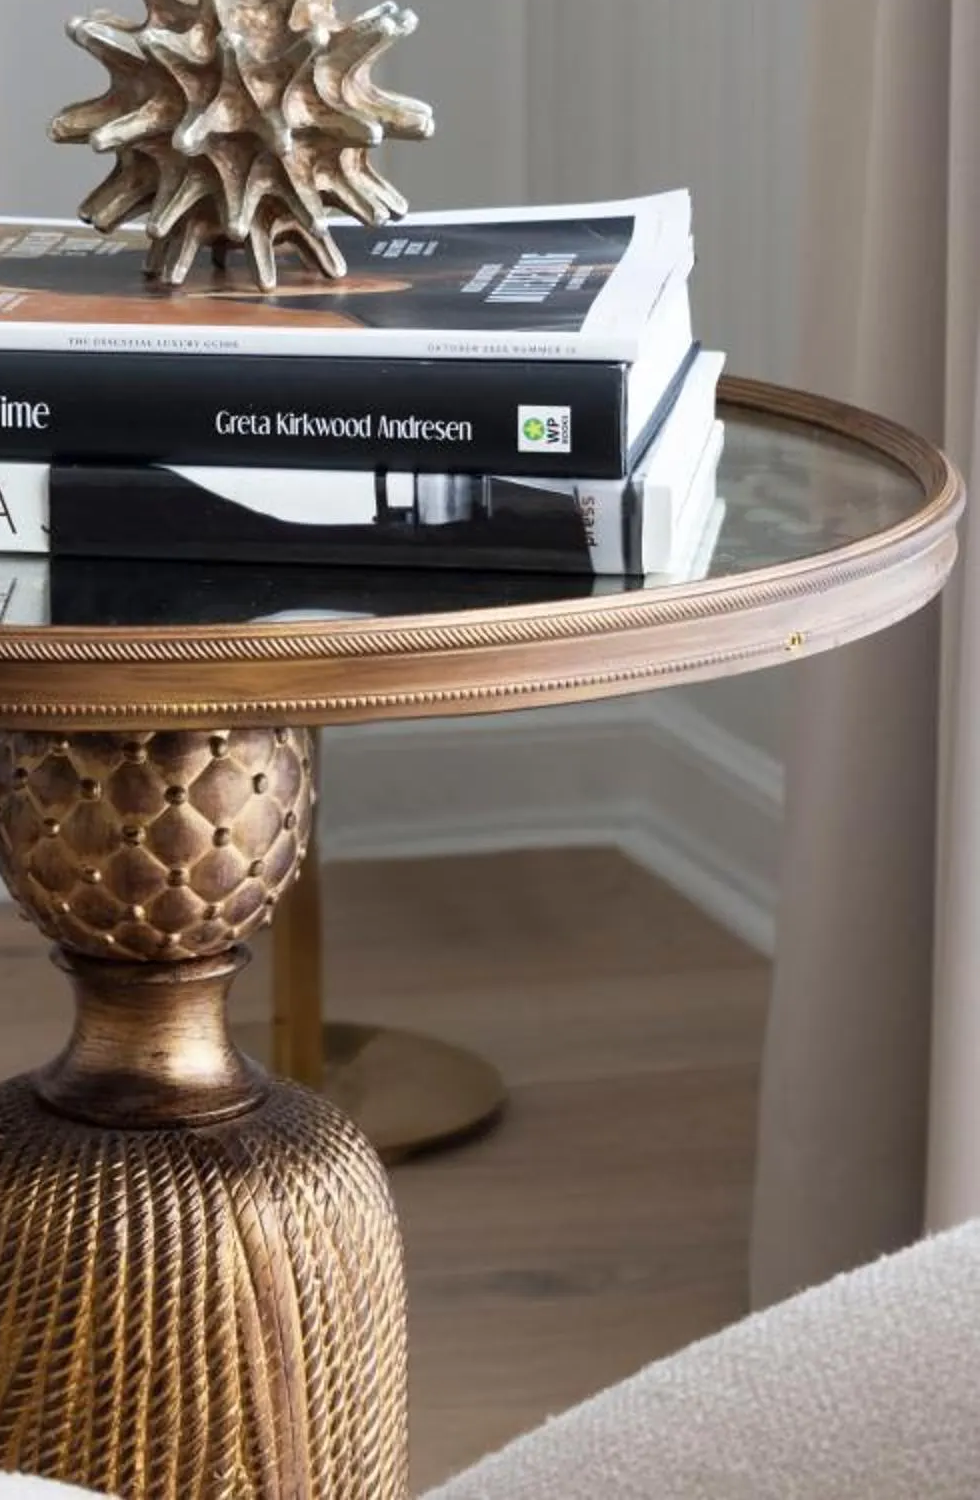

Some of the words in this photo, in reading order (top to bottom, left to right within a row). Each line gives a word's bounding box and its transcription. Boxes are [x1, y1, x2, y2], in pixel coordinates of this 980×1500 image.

[69, 338, 88, 347] THE
[215, 410, 270, 435] Greta
[276, 411, 371, 438] Kirkwood
[377, 414, 473, 441] Andresen
[546, 416, 560, 444] WP
